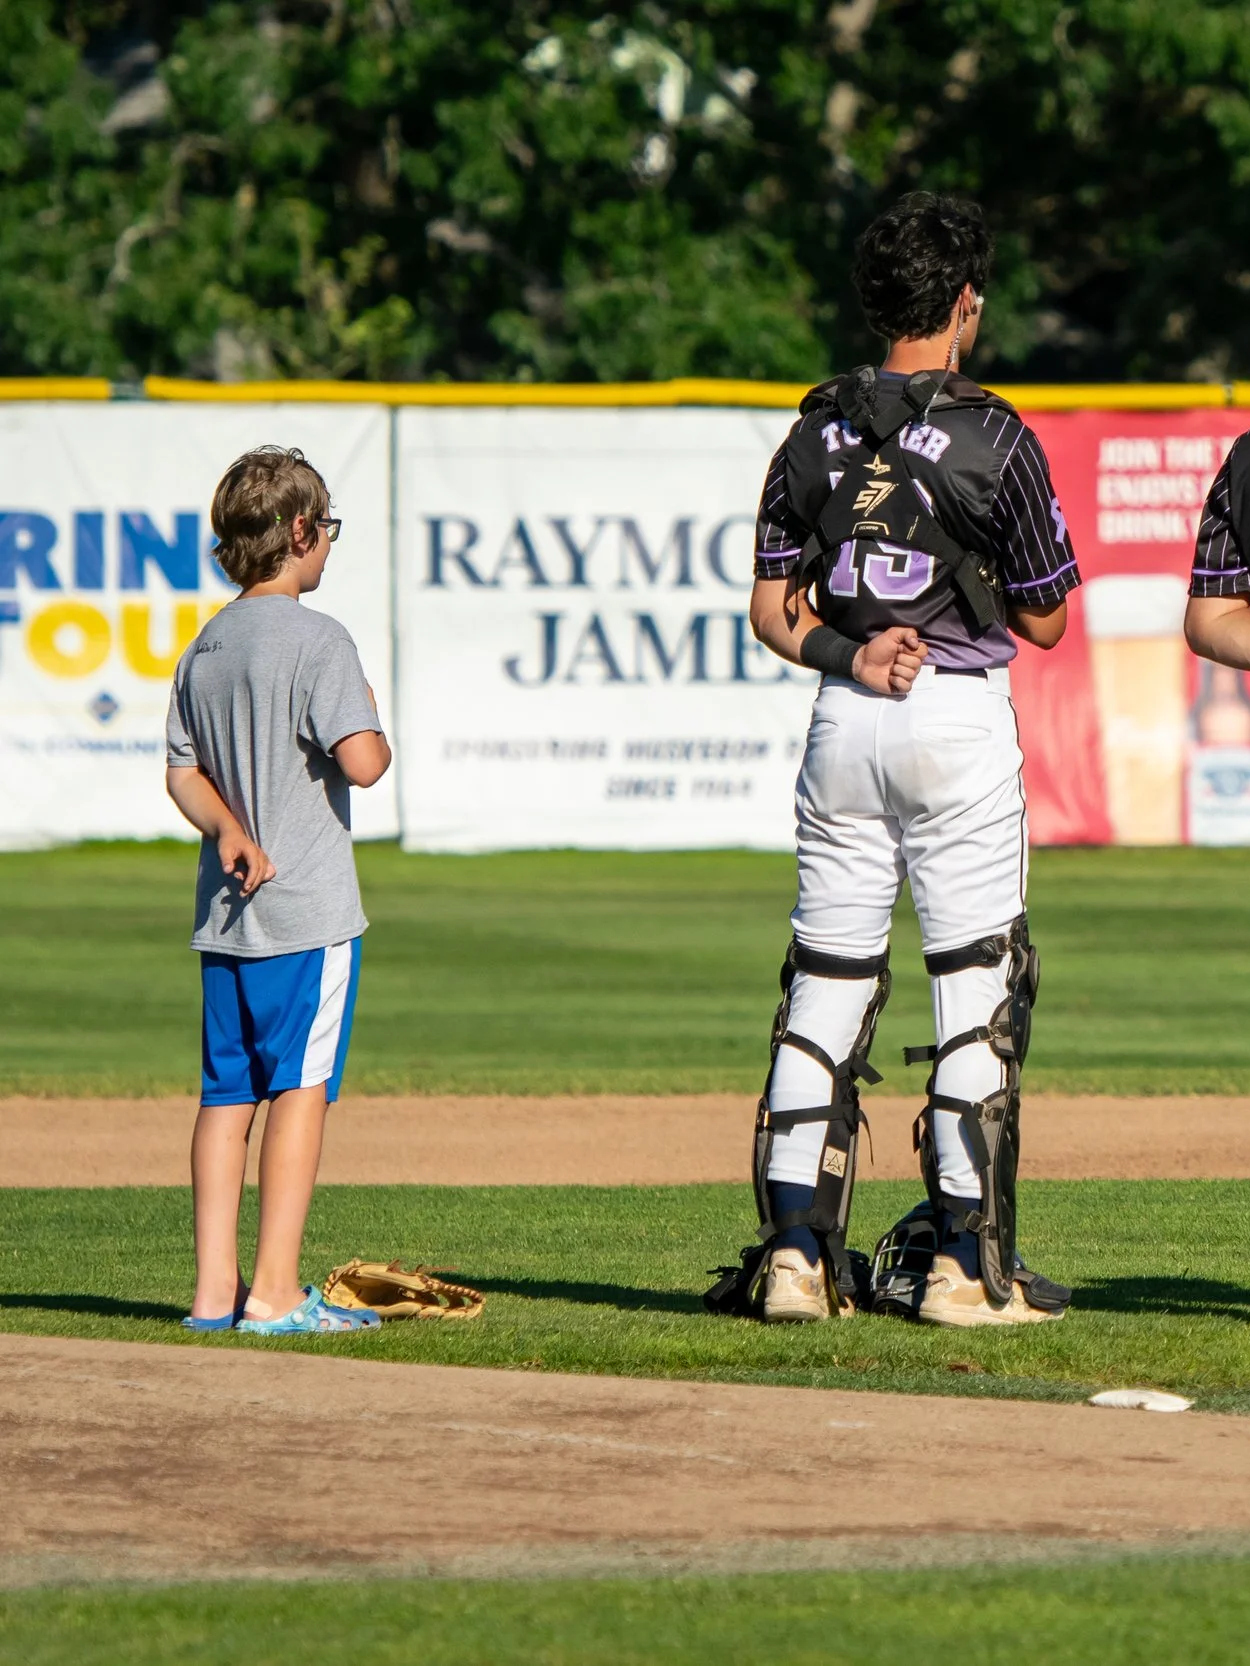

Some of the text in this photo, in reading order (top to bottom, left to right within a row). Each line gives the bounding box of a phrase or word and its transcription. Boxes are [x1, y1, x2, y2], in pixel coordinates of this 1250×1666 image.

[821, 421, 951, 464] TER
[1098, 436, 1160, 471] JOIN
[1164, 435, 1213, 471] THE
